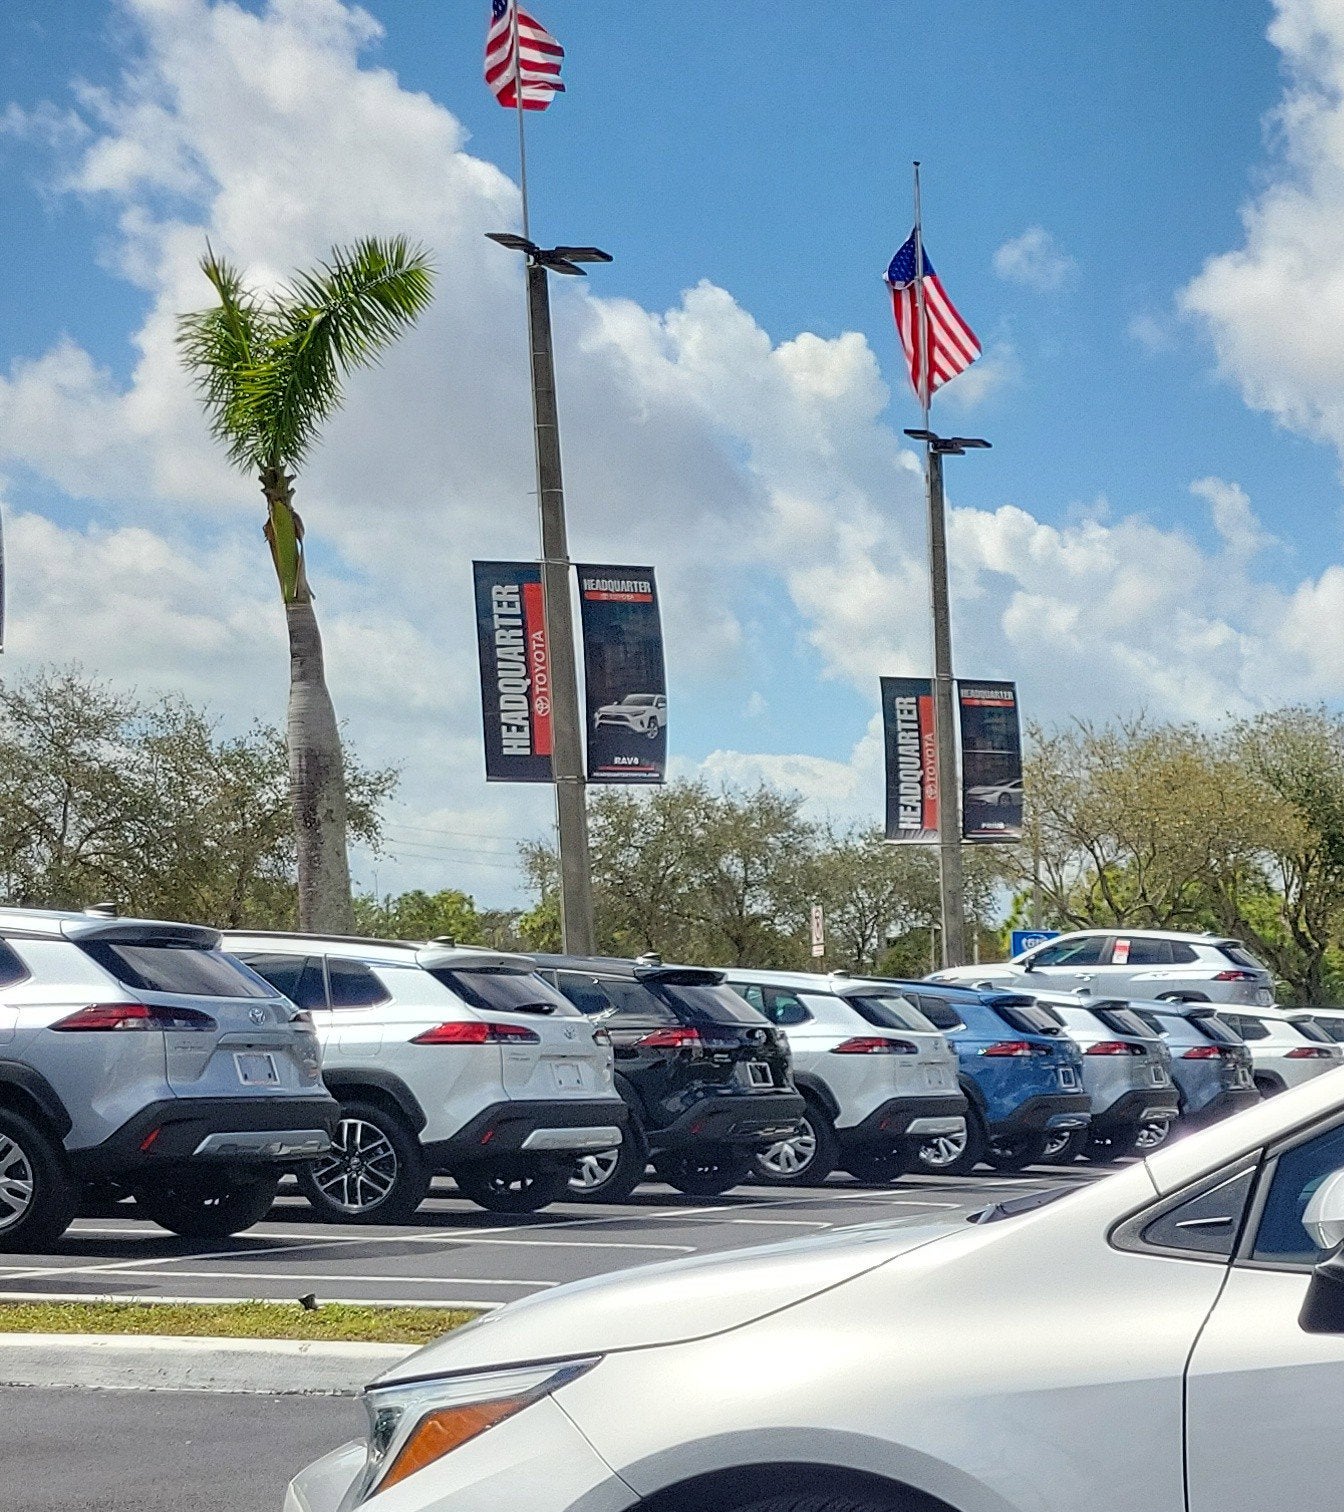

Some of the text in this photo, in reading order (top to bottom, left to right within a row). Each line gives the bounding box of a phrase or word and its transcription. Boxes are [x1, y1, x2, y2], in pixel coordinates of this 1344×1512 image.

[583, 579, 652, 593] HEADQUARTER
[492, 584, 532, 756] HEADQUARTER
[531, 630, 549, 694] TOYOTA
[613, 756, 639, 765] RAV4
[895, 696, 924, 830] HEADQUARTER
[924, 733, 937, 782] TOYOTA
